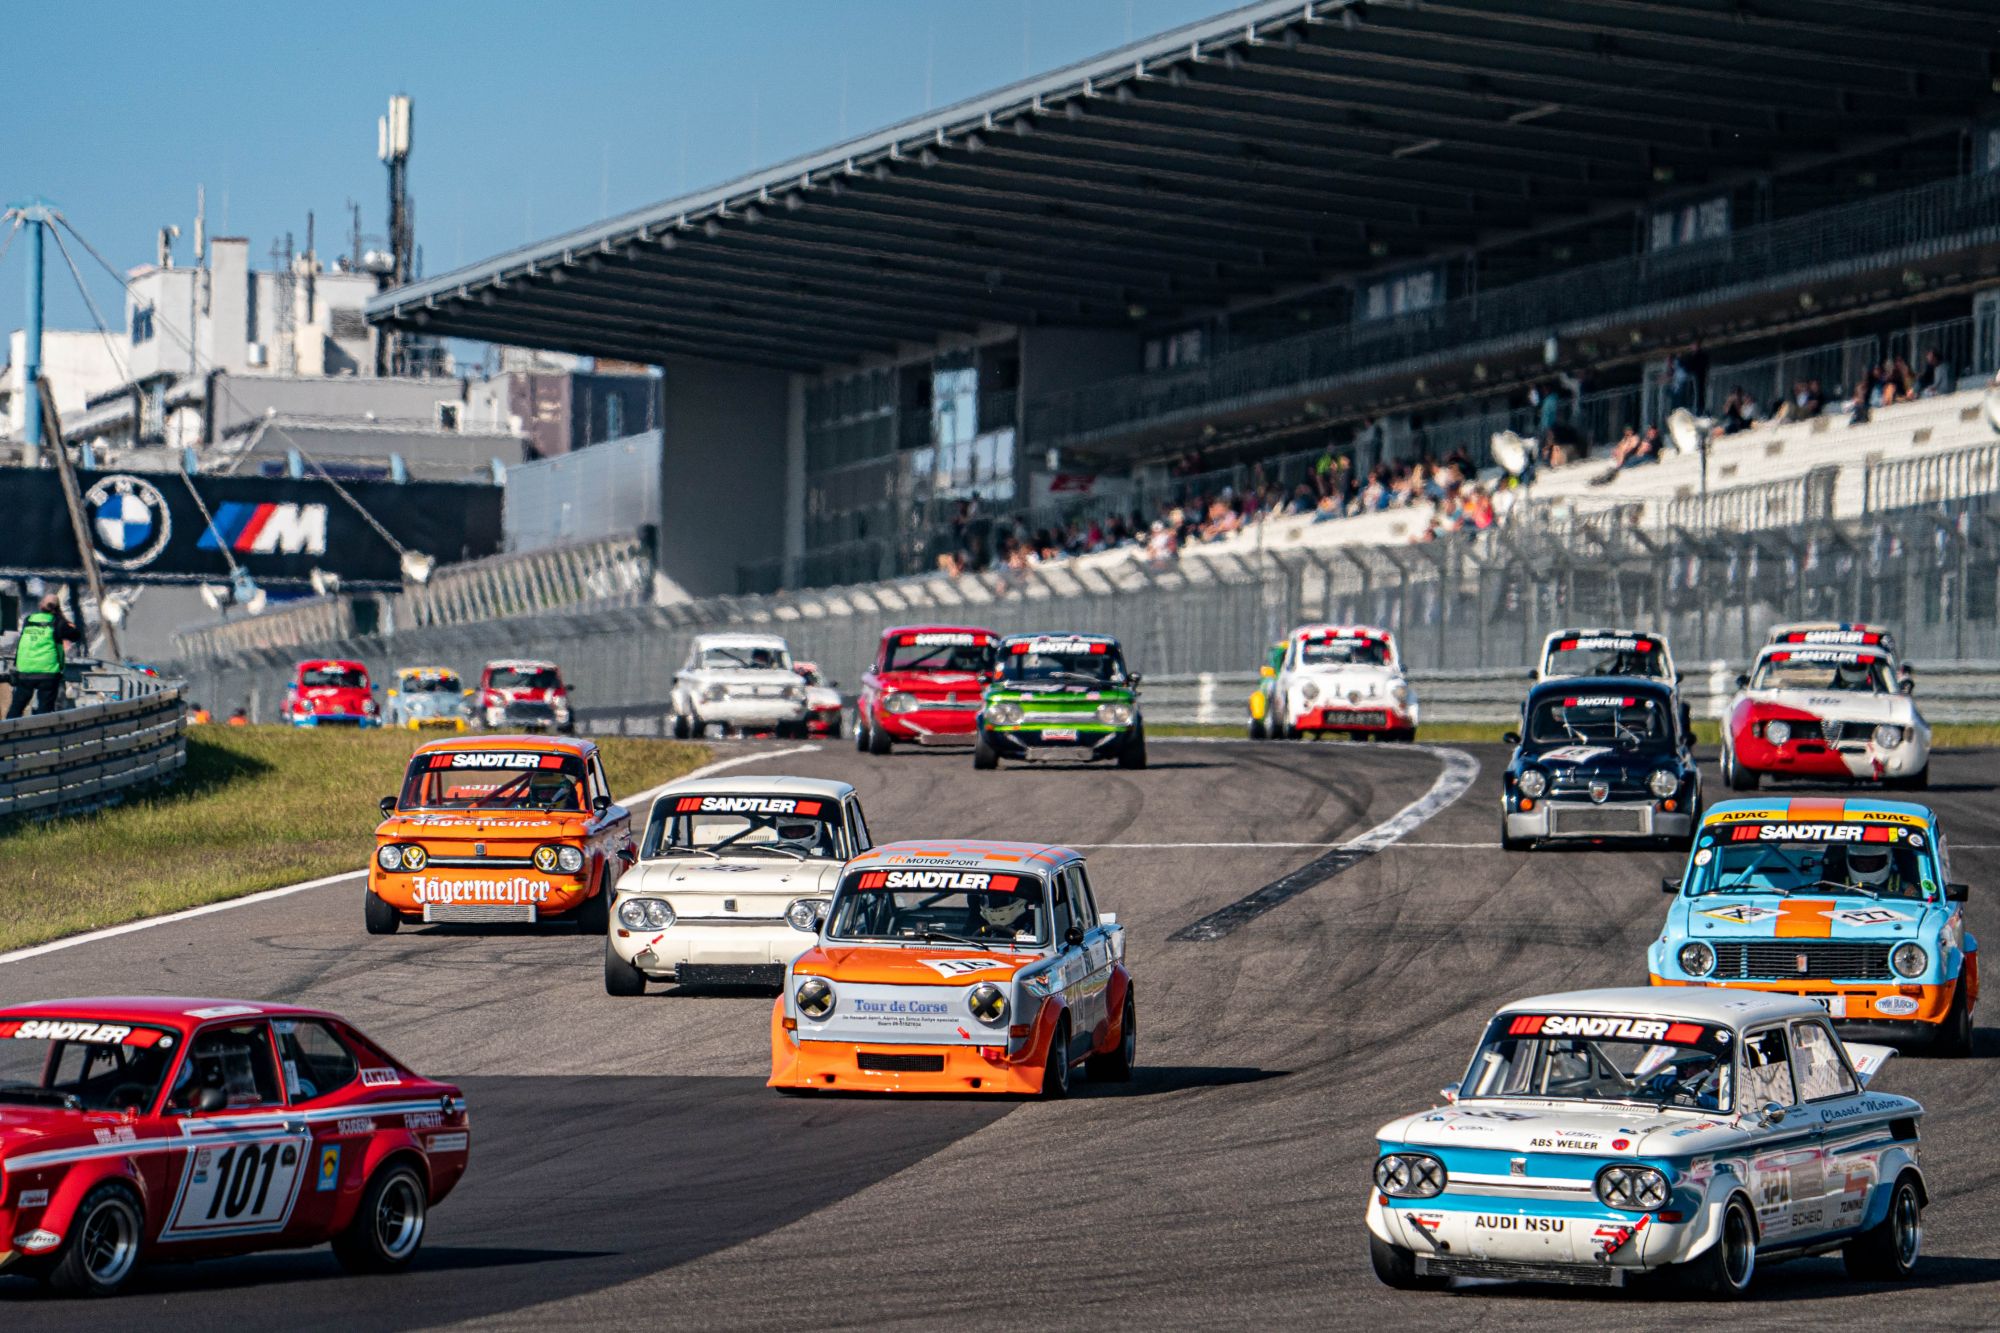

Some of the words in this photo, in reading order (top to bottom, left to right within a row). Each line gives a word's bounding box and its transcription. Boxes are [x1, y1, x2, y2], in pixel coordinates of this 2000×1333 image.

[451, 753, 540, 769] SANDTLER
[700, 797, 797, 813] SANDTLER
[1722, 811, 1769, 820] ADAC
[1863, 812, 1911, 822] ADAC
[1758, 824, 1865, 841] SANDTLER
[885, 872, 992, 890] SANDTLER
[1841, 910, 1895, 922] 177
[855, 999, 888, 1012] Tour
[890, 1000, 906, 1012] de
[909, 1001, 948, 1013] Corse
[14, 1020, 132, 1044] SANDTLER
[1541, 1016, 1670, 1040] SANDTLER
[1820, 1105, 1863, 1124] Classic
[1861, 1099, 1904, 1114] Motors
[1530, 1138, 1553, 1148] ABS
[1556, 1138, 1599, 1150] WEILER
[205, 1143, 281, 1220] 101
[1475, 1215, 1518, 1230] AUDI
[1525, 1217, 1565, 1233] NSU
[1791, 1209, 1823, 1227] SCHEID
